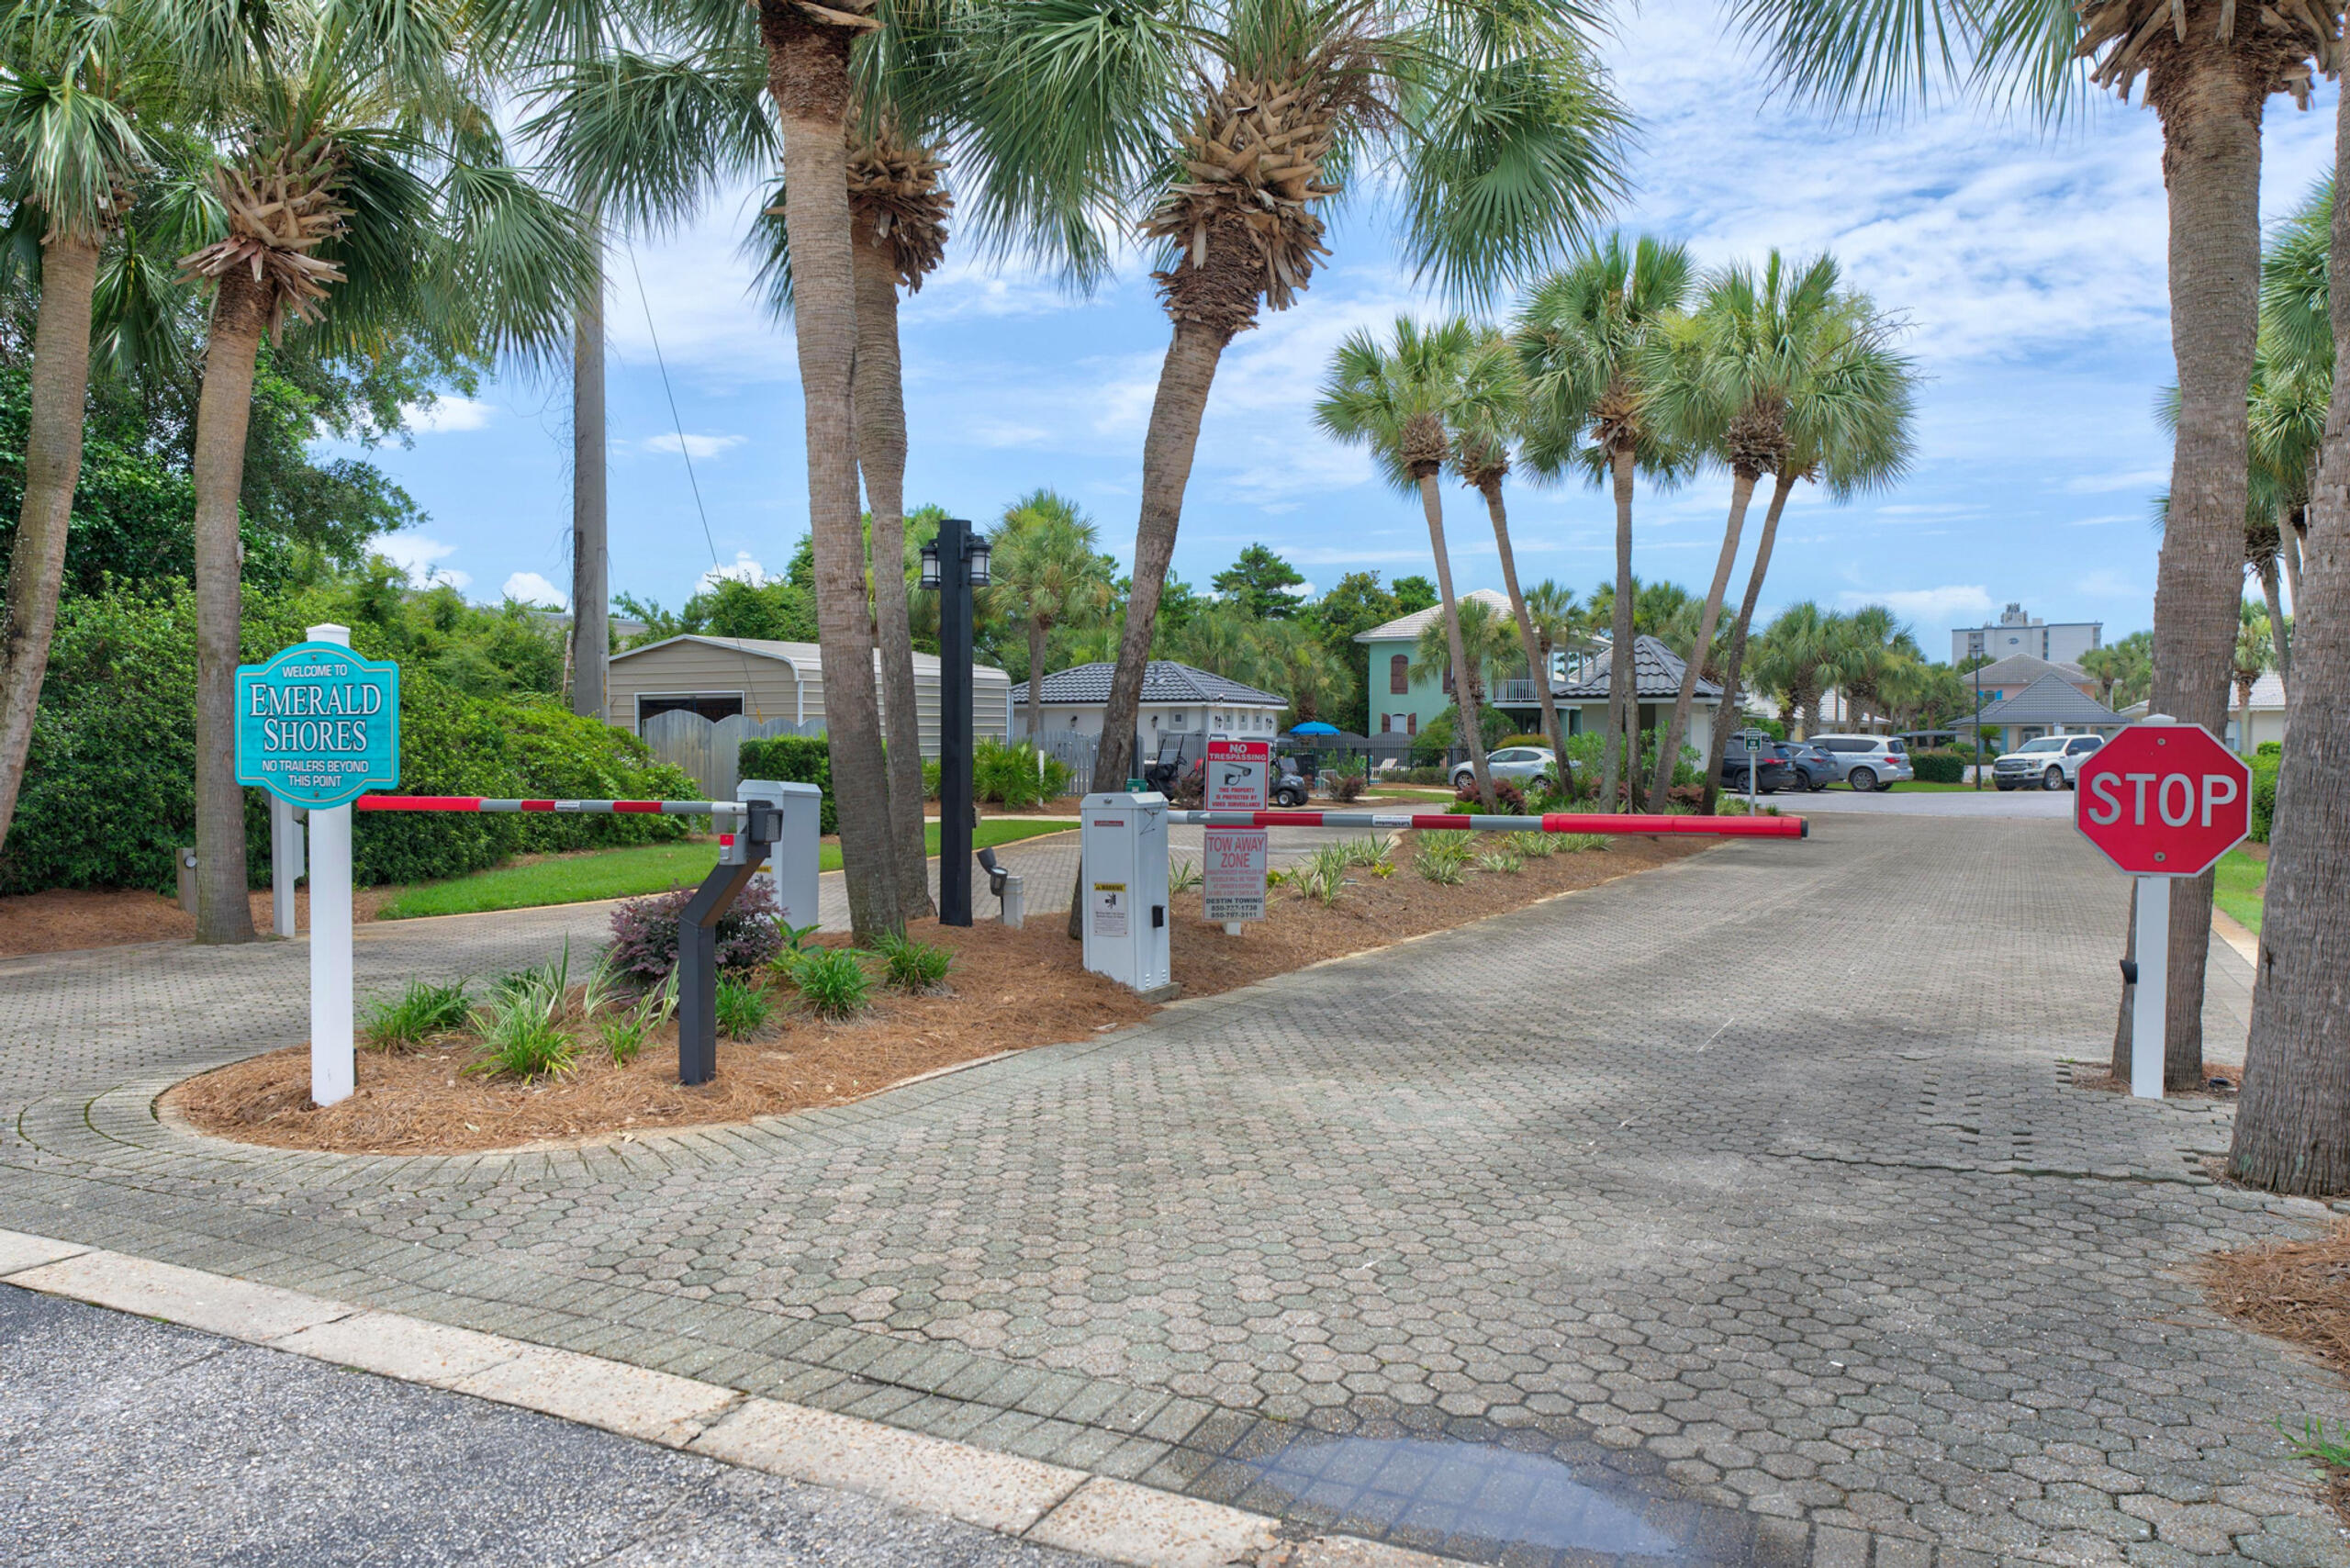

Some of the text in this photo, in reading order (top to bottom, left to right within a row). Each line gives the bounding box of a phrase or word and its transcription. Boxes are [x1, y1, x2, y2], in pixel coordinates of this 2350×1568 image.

[282, 664, 348, 678] WELCOME TO
[250, 683, 382, 716] EMERALD
[263, 718, 368, 752] SHORES
[1229, 744, 1248, 754] NO
[1209, 753, 1267, 761] TRESPASSING
[263, 760, 369, 773] NO TRAILERS BEYOND
[288, 775, 342, 788] THIS POINT
[2087, 772, 2238, 827] STOP
[1208, 836, 1264, 852] TOW AWAY
[1221, 853, 1250, 868] ZONE
